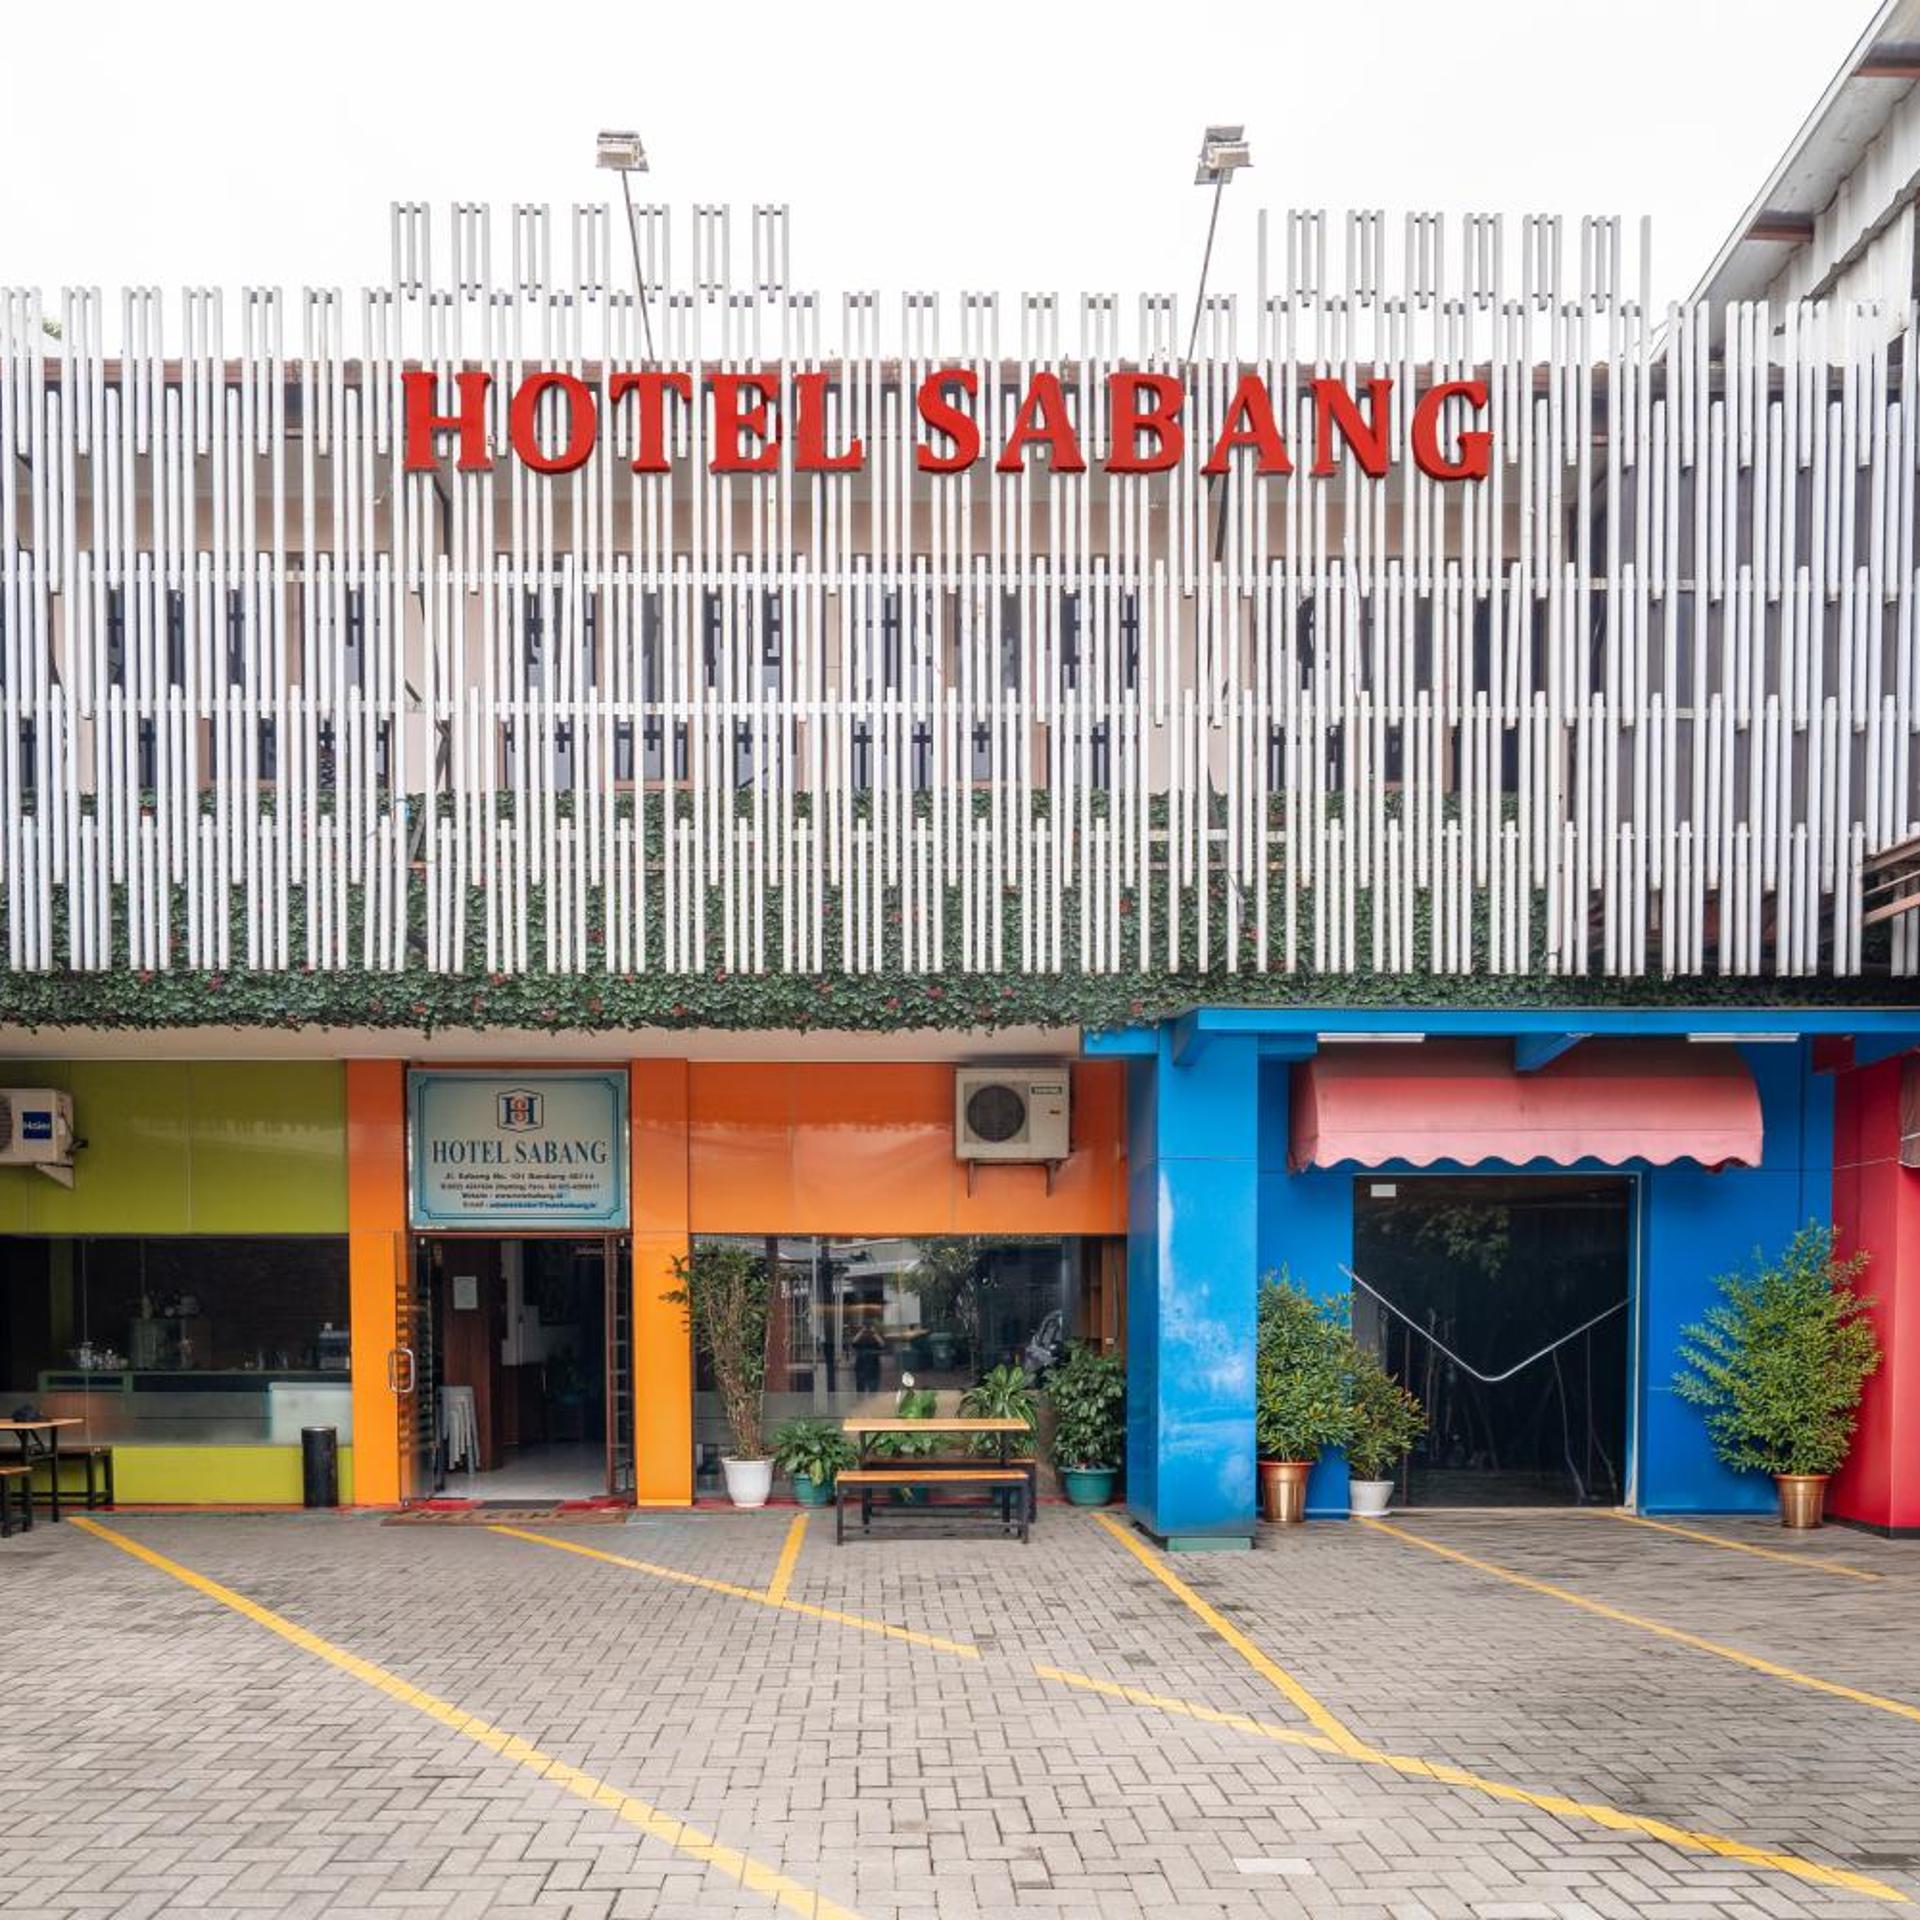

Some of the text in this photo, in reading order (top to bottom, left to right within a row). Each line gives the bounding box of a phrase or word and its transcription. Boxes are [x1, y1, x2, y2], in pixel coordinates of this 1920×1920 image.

[401, 368, 1492, 479] HOTEL SABANG
[432, 1139, 608, 1164] HOTEL SABANG
